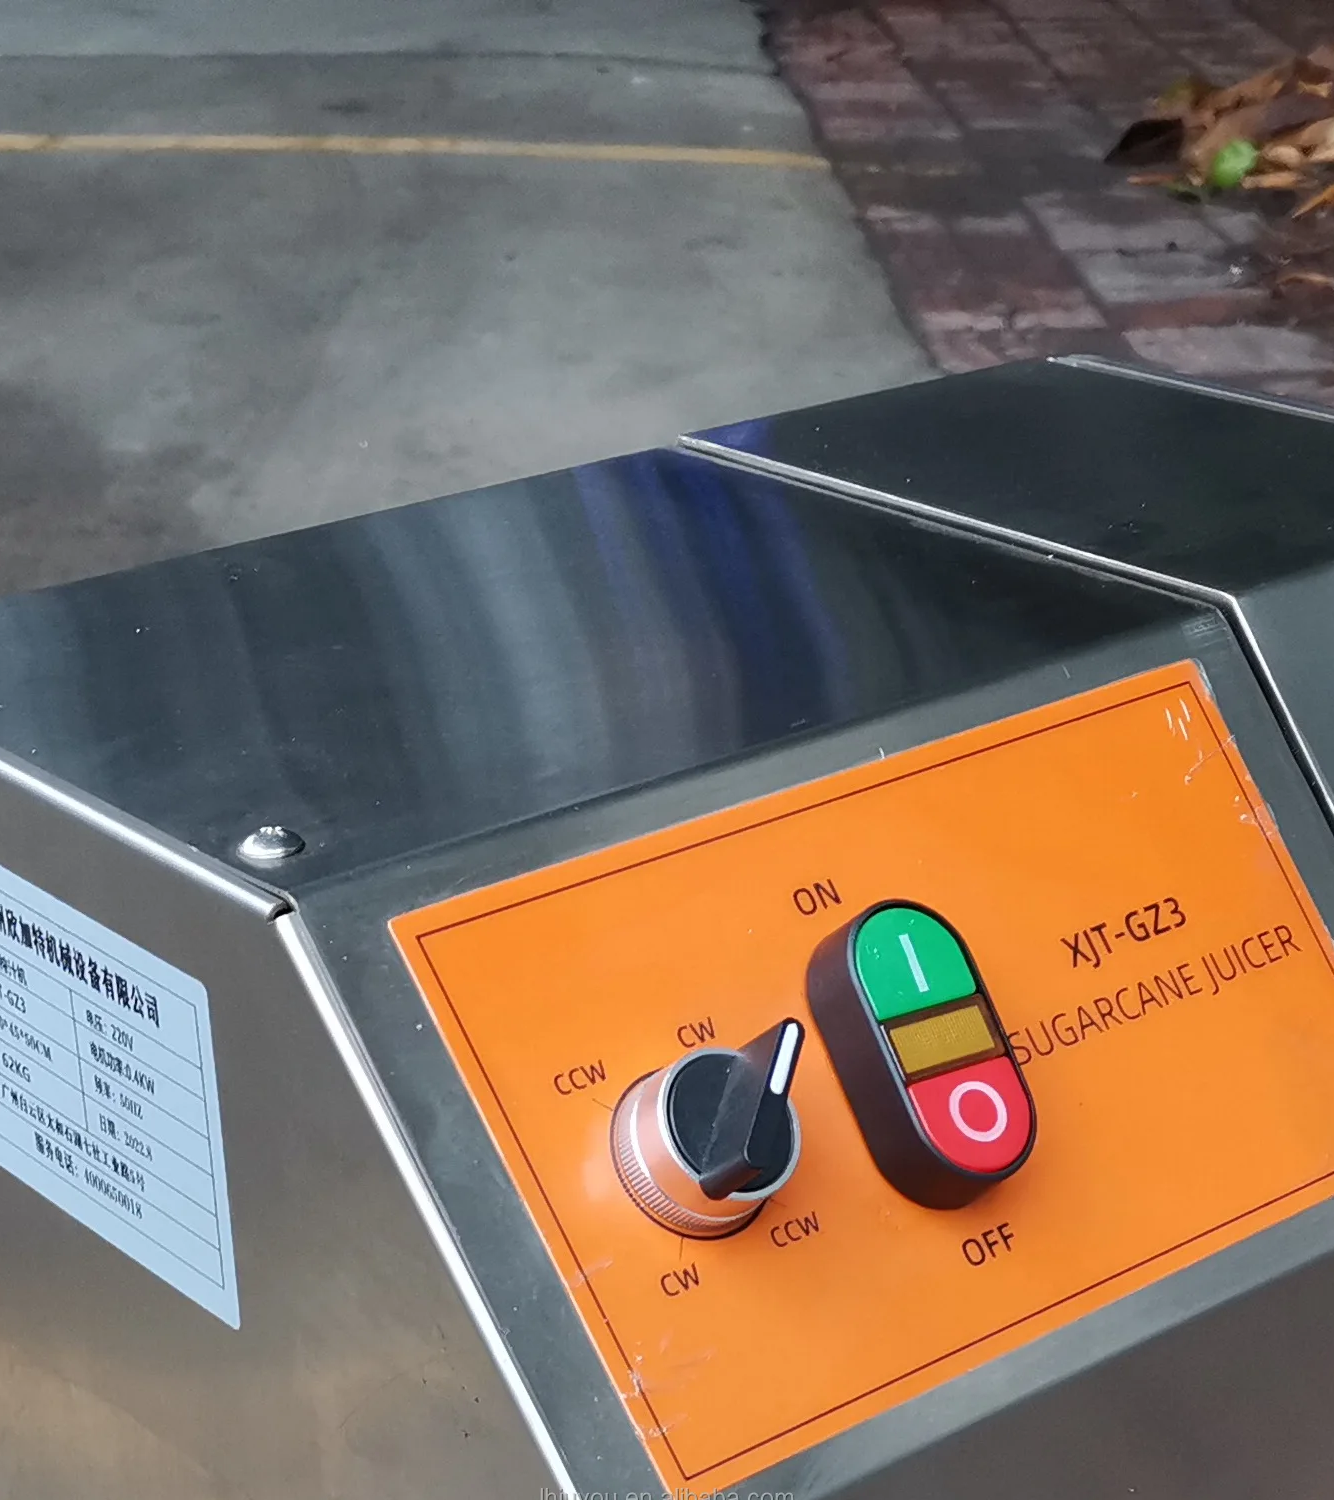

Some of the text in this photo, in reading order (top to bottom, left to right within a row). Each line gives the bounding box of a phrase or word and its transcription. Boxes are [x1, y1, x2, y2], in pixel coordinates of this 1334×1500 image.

[792, 878, 843, 916] ON
[1060, 896, 1187, 969] XJT-GZ3
[1007, 923, 1304, 1067] SUGARCANE JUICER
[676, 1016, 717, 1049] CW
[553, 1059, 608, 1096] CCW
[770, 1211, 821, 1248] CCW
[961, 1222, 1015, 1267] OFF
[660, 1262, 701, 1298] CW
